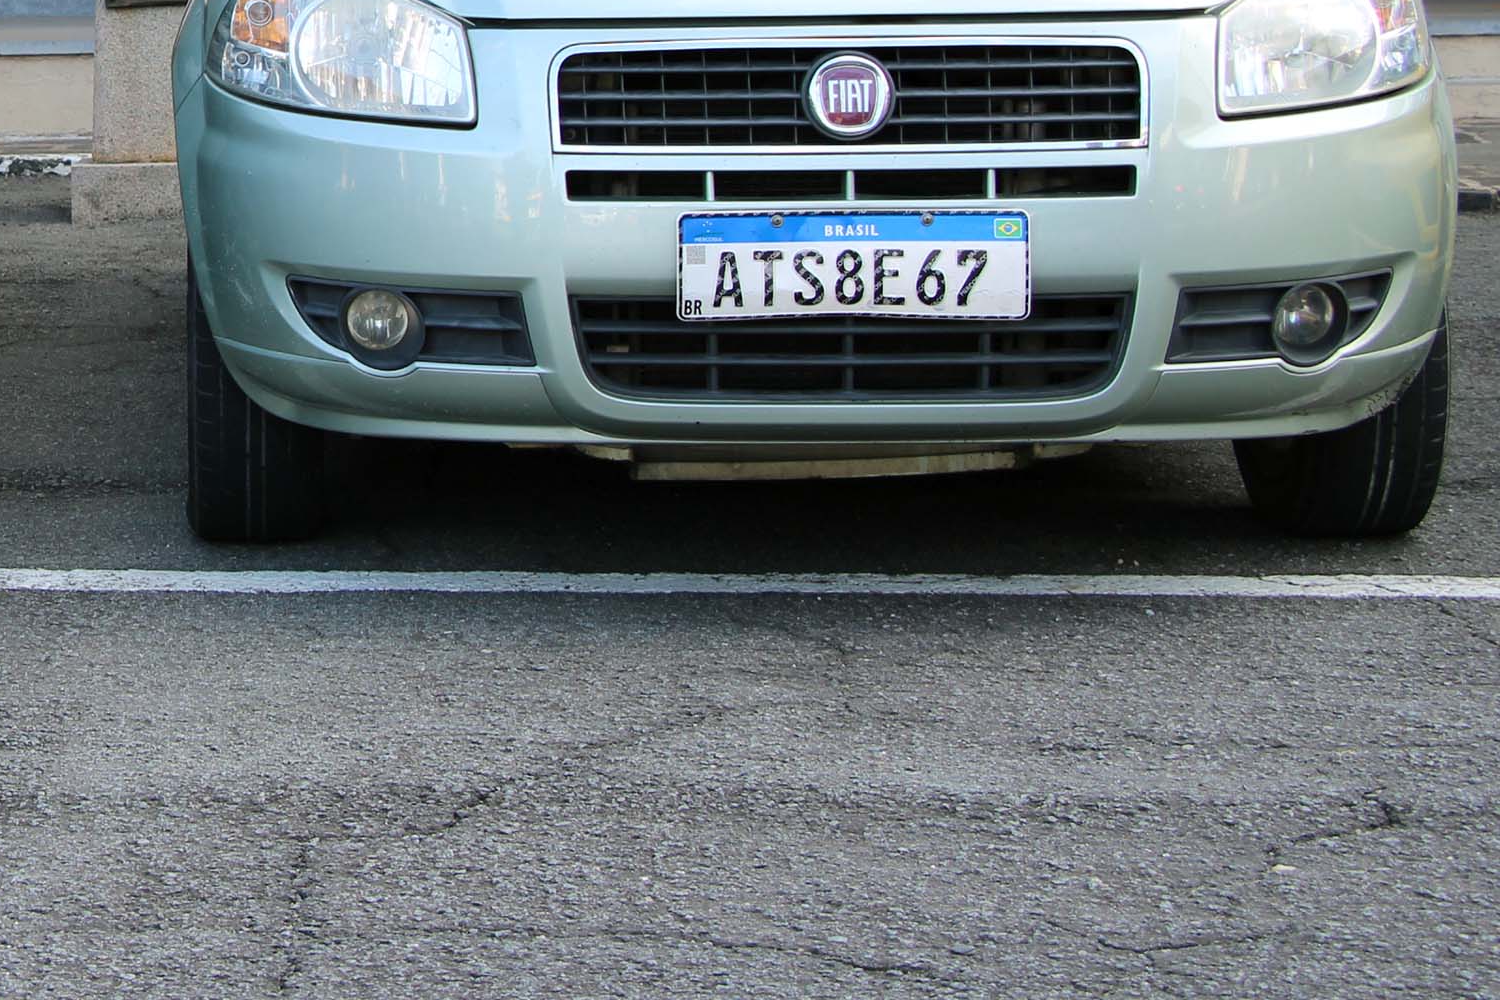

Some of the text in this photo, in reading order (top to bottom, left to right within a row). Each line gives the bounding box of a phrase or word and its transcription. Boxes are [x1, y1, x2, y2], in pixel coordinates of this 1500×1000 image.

[828, 79, 873, 113] FIAT
[824, 224, 880, 237] BRASIL
[712, 248, 988, 307] ATS8E67
[684, 299, 702, 315] BR
